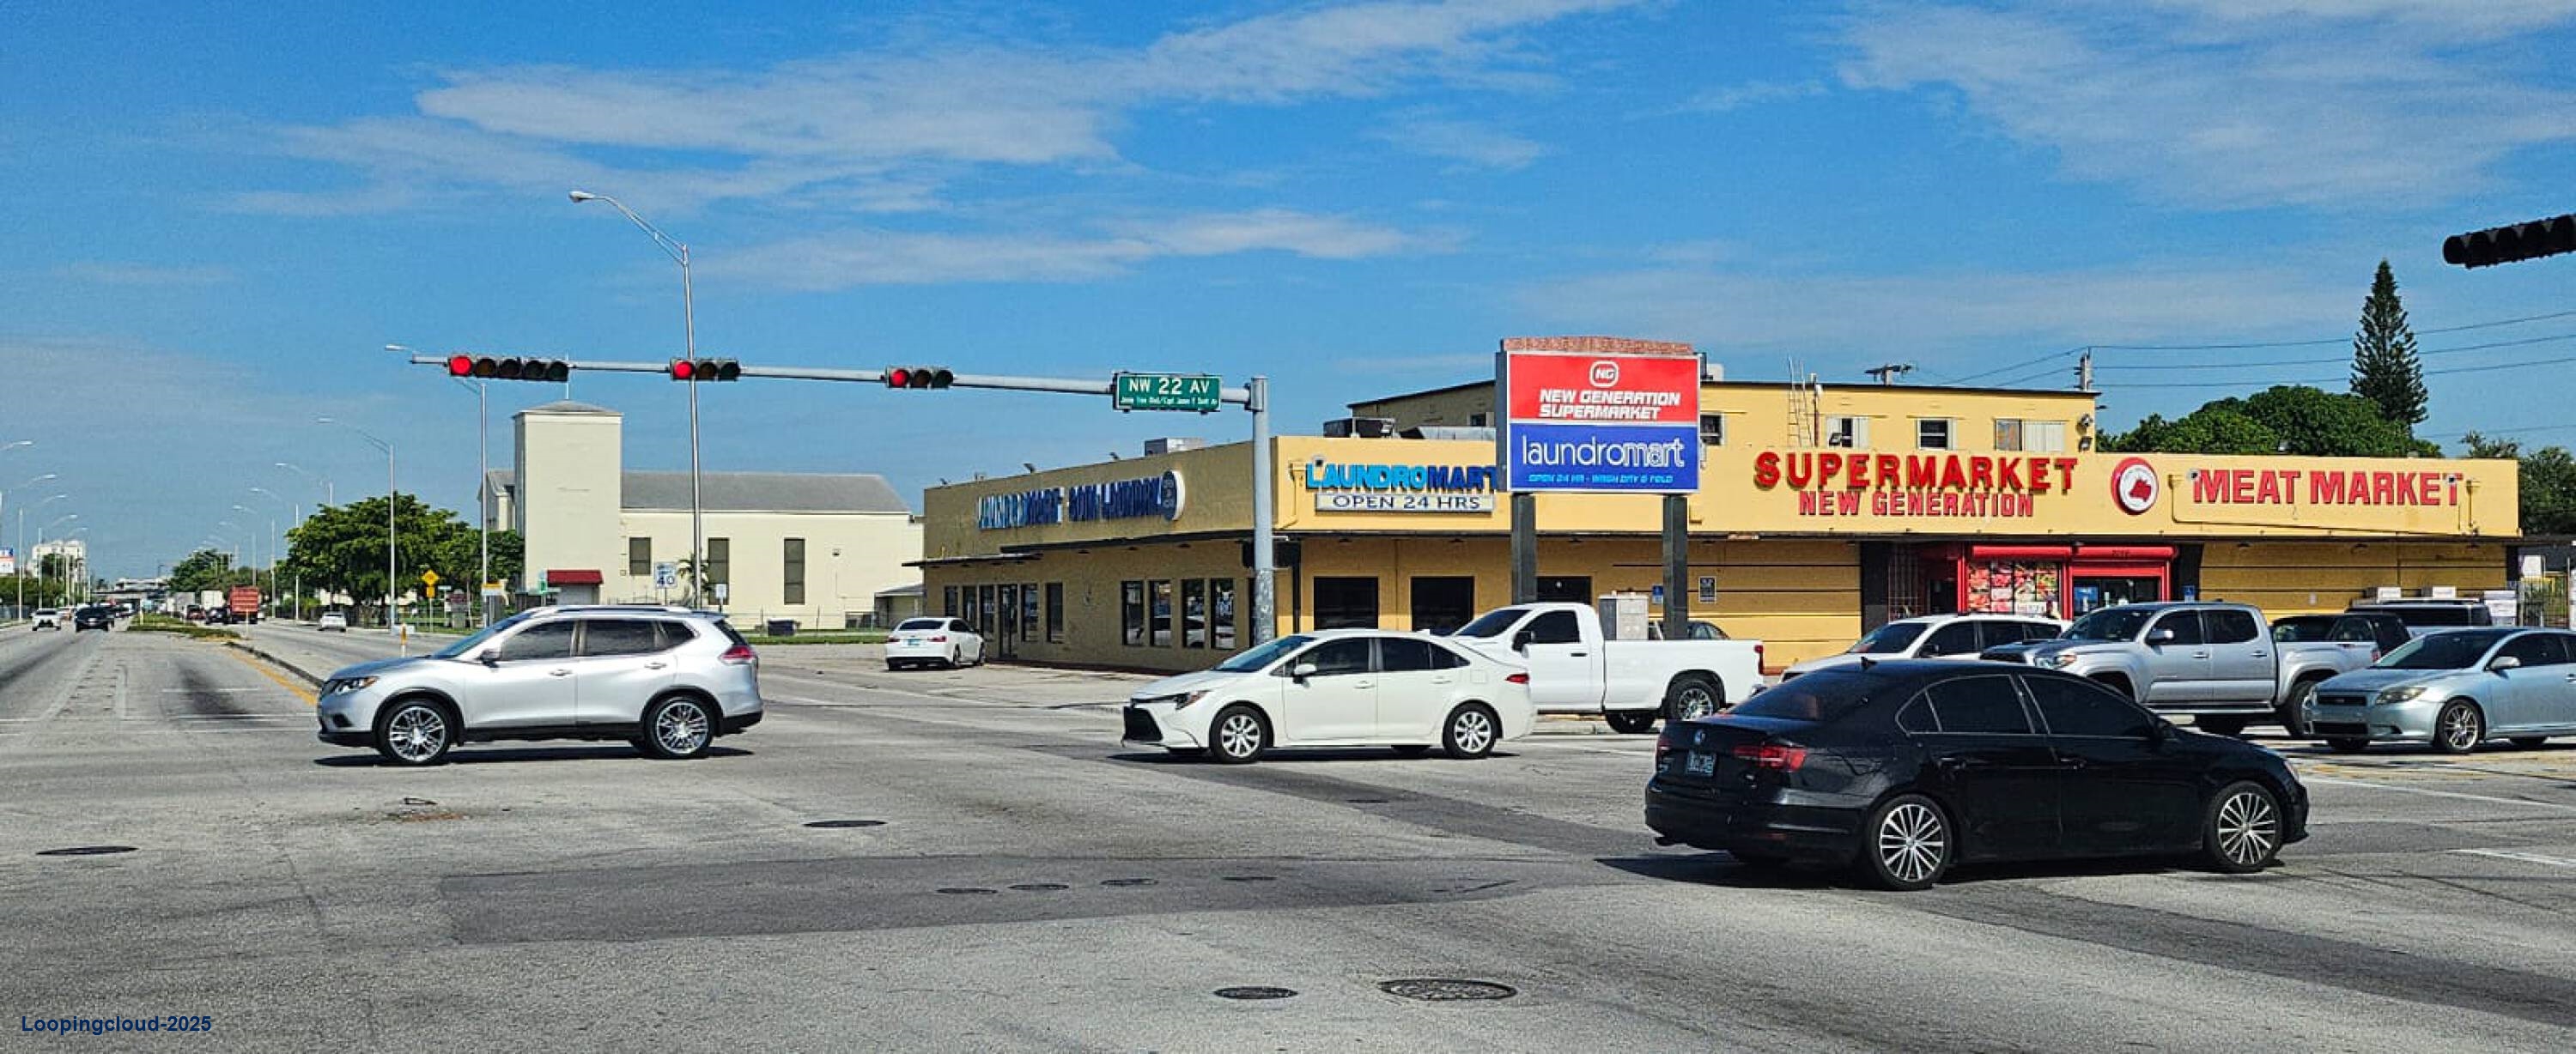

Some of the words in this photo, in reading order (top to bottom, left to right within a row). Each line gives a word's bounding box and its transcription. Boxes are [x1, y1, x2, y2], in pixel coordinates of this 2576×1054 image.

[1128, 379, 1151, 392] NW
[1158, 378, 1182, 395] 22
[1189, 379, 1210, 394] AV
[1539, 389, 1577, 404] NEW
[1579, 391, 1681, 406] GENERATION
[1539, 403, 1662, 420] SUPERMARKET
[1522, 433, 1685, 468] laundromart
[1306, 463, 1498, 491] LAUNDROMART
[1754, 451, 2079, 494] SUPERMARKET
[2192, 469, 2301, 505] MEAT
[2309, 471, 2464, 506] MARKET
[1332, 494, 1395, 510] OPEN
[1403, 495, 1430, 510] 24
[1437, 495, 1481, 510] HRS
[1799, 490, 1861, 516] NEW
[1871, 491, 2034, 517] GENERATION
